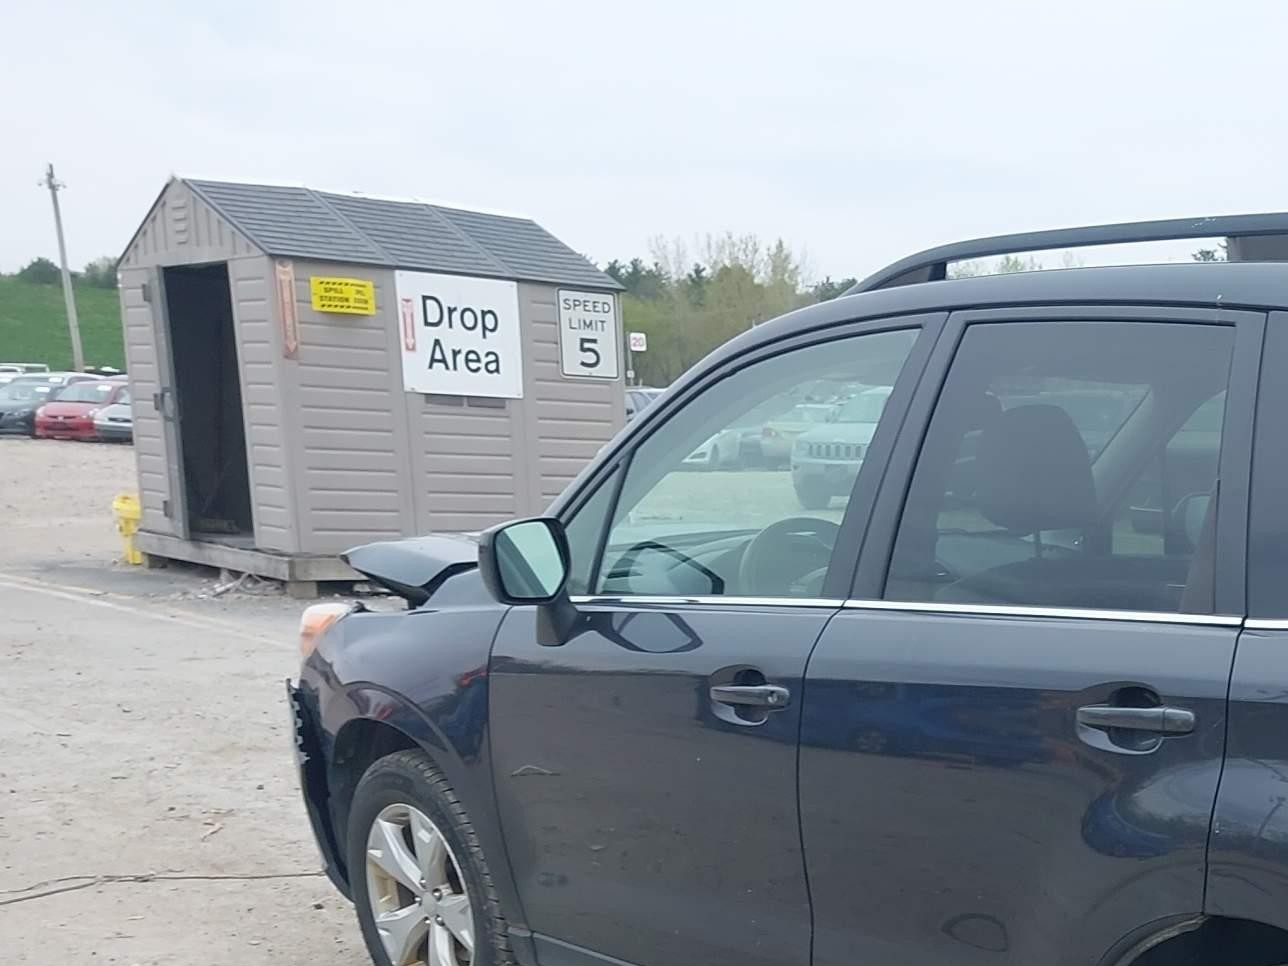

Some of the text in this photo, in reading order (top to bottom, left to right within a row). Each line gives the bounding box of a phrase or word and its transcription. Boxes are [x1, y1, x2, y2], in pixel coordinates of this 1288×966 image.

[421, 294, 499, 339] Drop
[562, 298, 611, 314] SPEED
[568, 317, 607, 332] LIMIT
[427, 338, 501, 375] Area
[579, 337, 601, 368] 5
